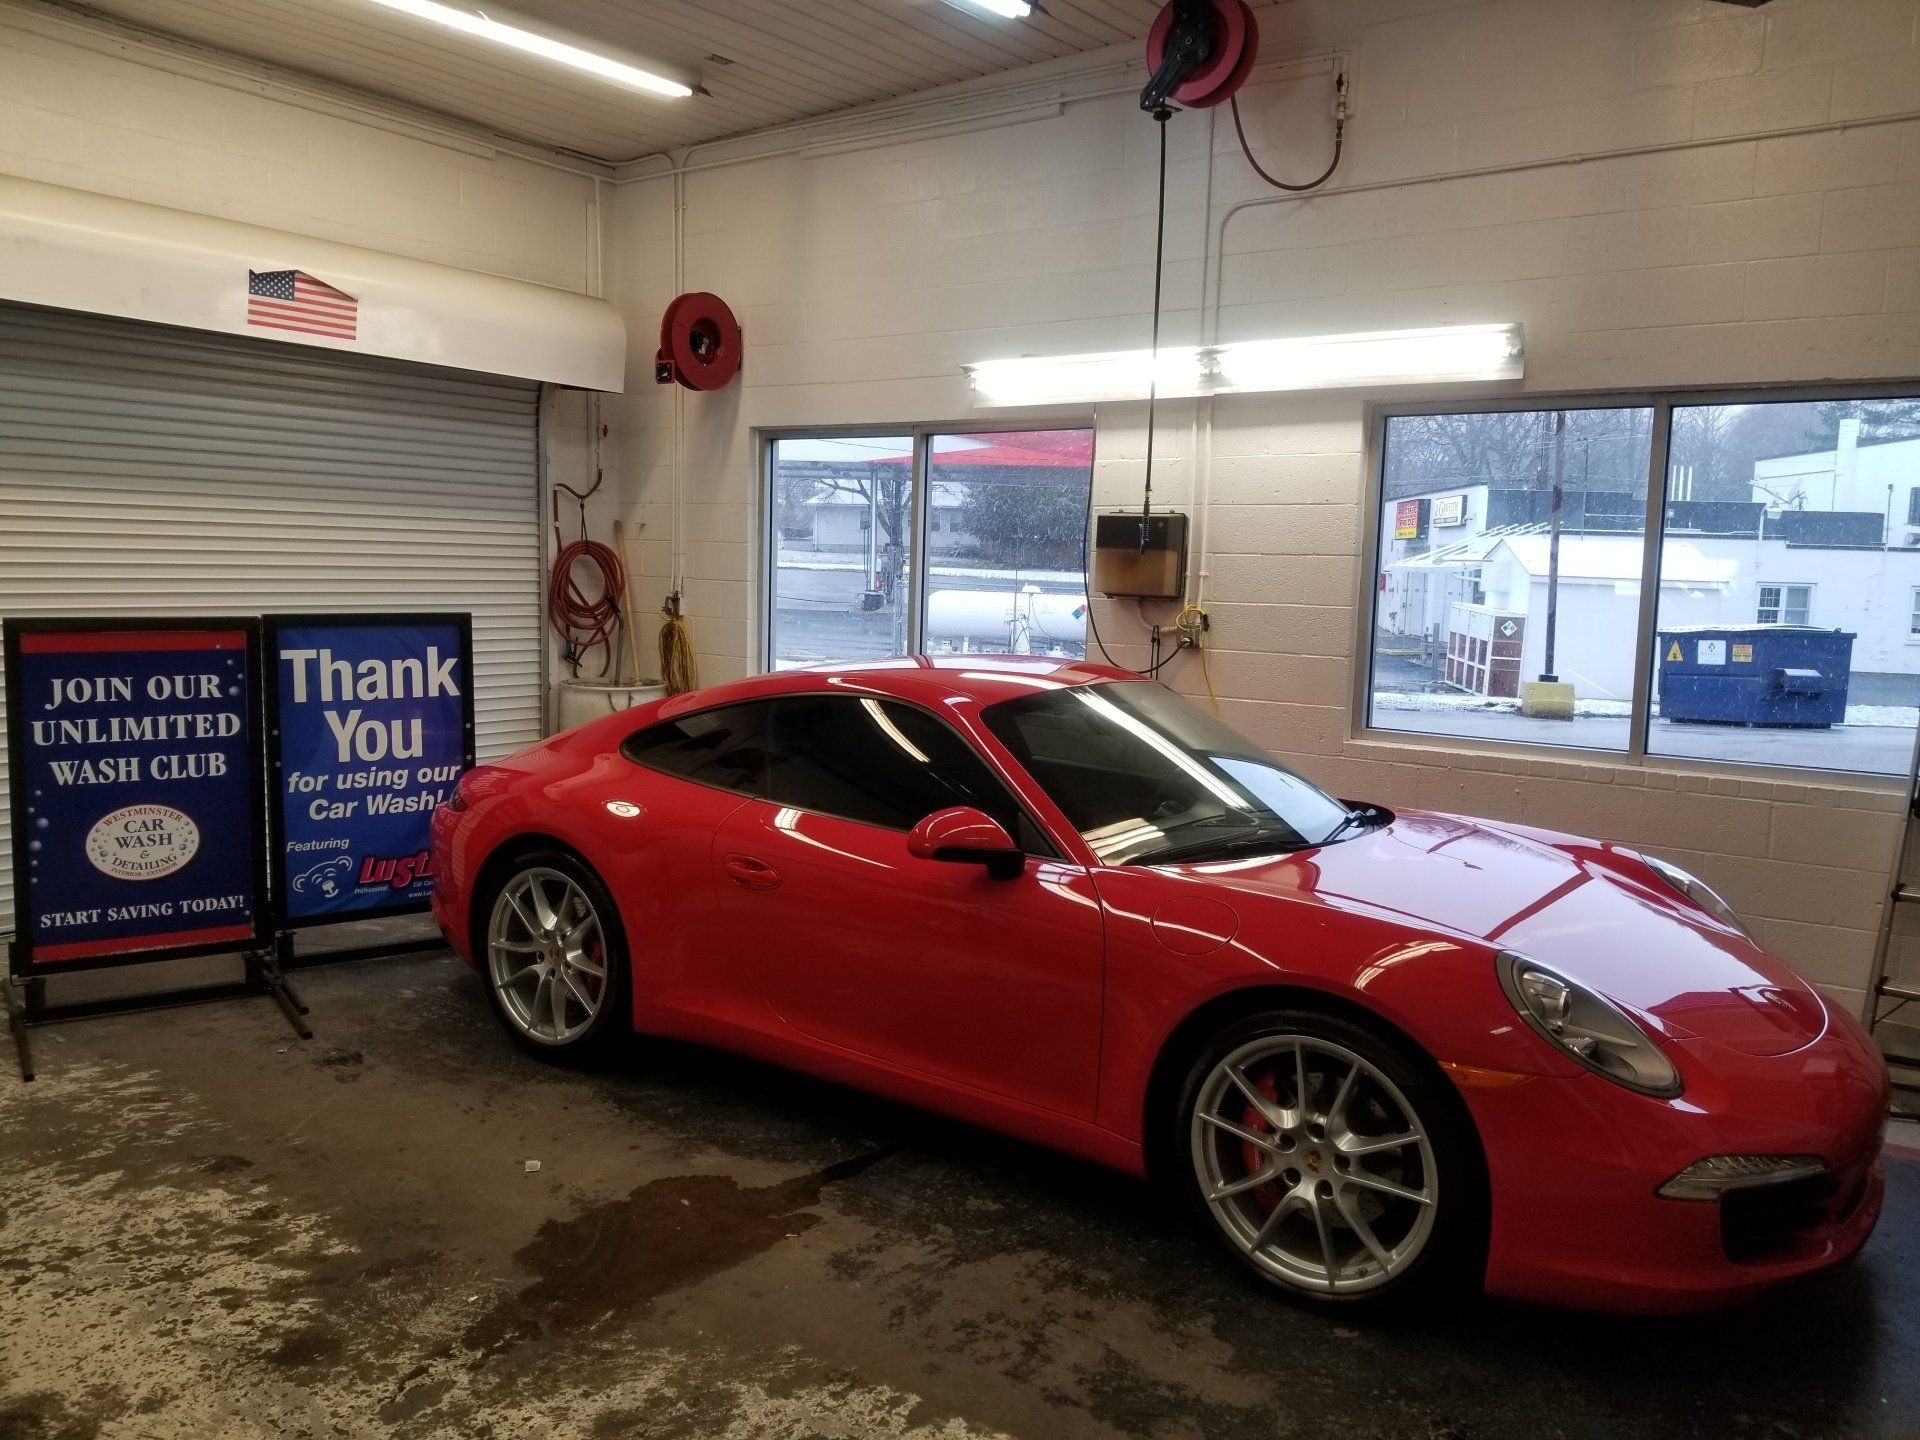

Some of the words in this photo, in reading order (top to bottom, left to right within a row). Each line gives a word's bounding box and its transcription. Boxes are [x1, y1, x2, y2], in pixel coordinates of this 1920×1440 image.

[1400, 518, 1415, 526] PRIDE
[280, 646, 461, 703] Thank
[45, 676, 133, 710] JOIN
[147, 674, 223, 700] OUR
[31, 713, 241, 746] UNLIMITED
[323, 709, 423, 762] You
[49, 757, 140, 786] WASH
[150, 752, 227, 781] CLUB
[288, 771, 329, 793] for
[336, 766, 409, 790] using
[417, 764, 461, 783] our
[103, 807, 183, 827] WESTMINSTER
[309, 798, 358, 821] Car
[367, 789, 444, 816] Wash!
[123, 818, 165, 834] CAR
[114, 832, 173, 849] WASH
[286, 838, 350, 853] Featuring
[112, 853, 177, 871] DETAILING
[140, 850, 150, 859] &
[111, 867, 142, 877] INTERIOR
[146, 862, 178, 877] EXTERIOR
[359, 851, 434, 888] Lust
[354, 885, 388, 895] Professional
[40, 908, 101, 929] START
[107, 902, 173, 922] SAVING
[180, 894, 245, 914] TODAY!
